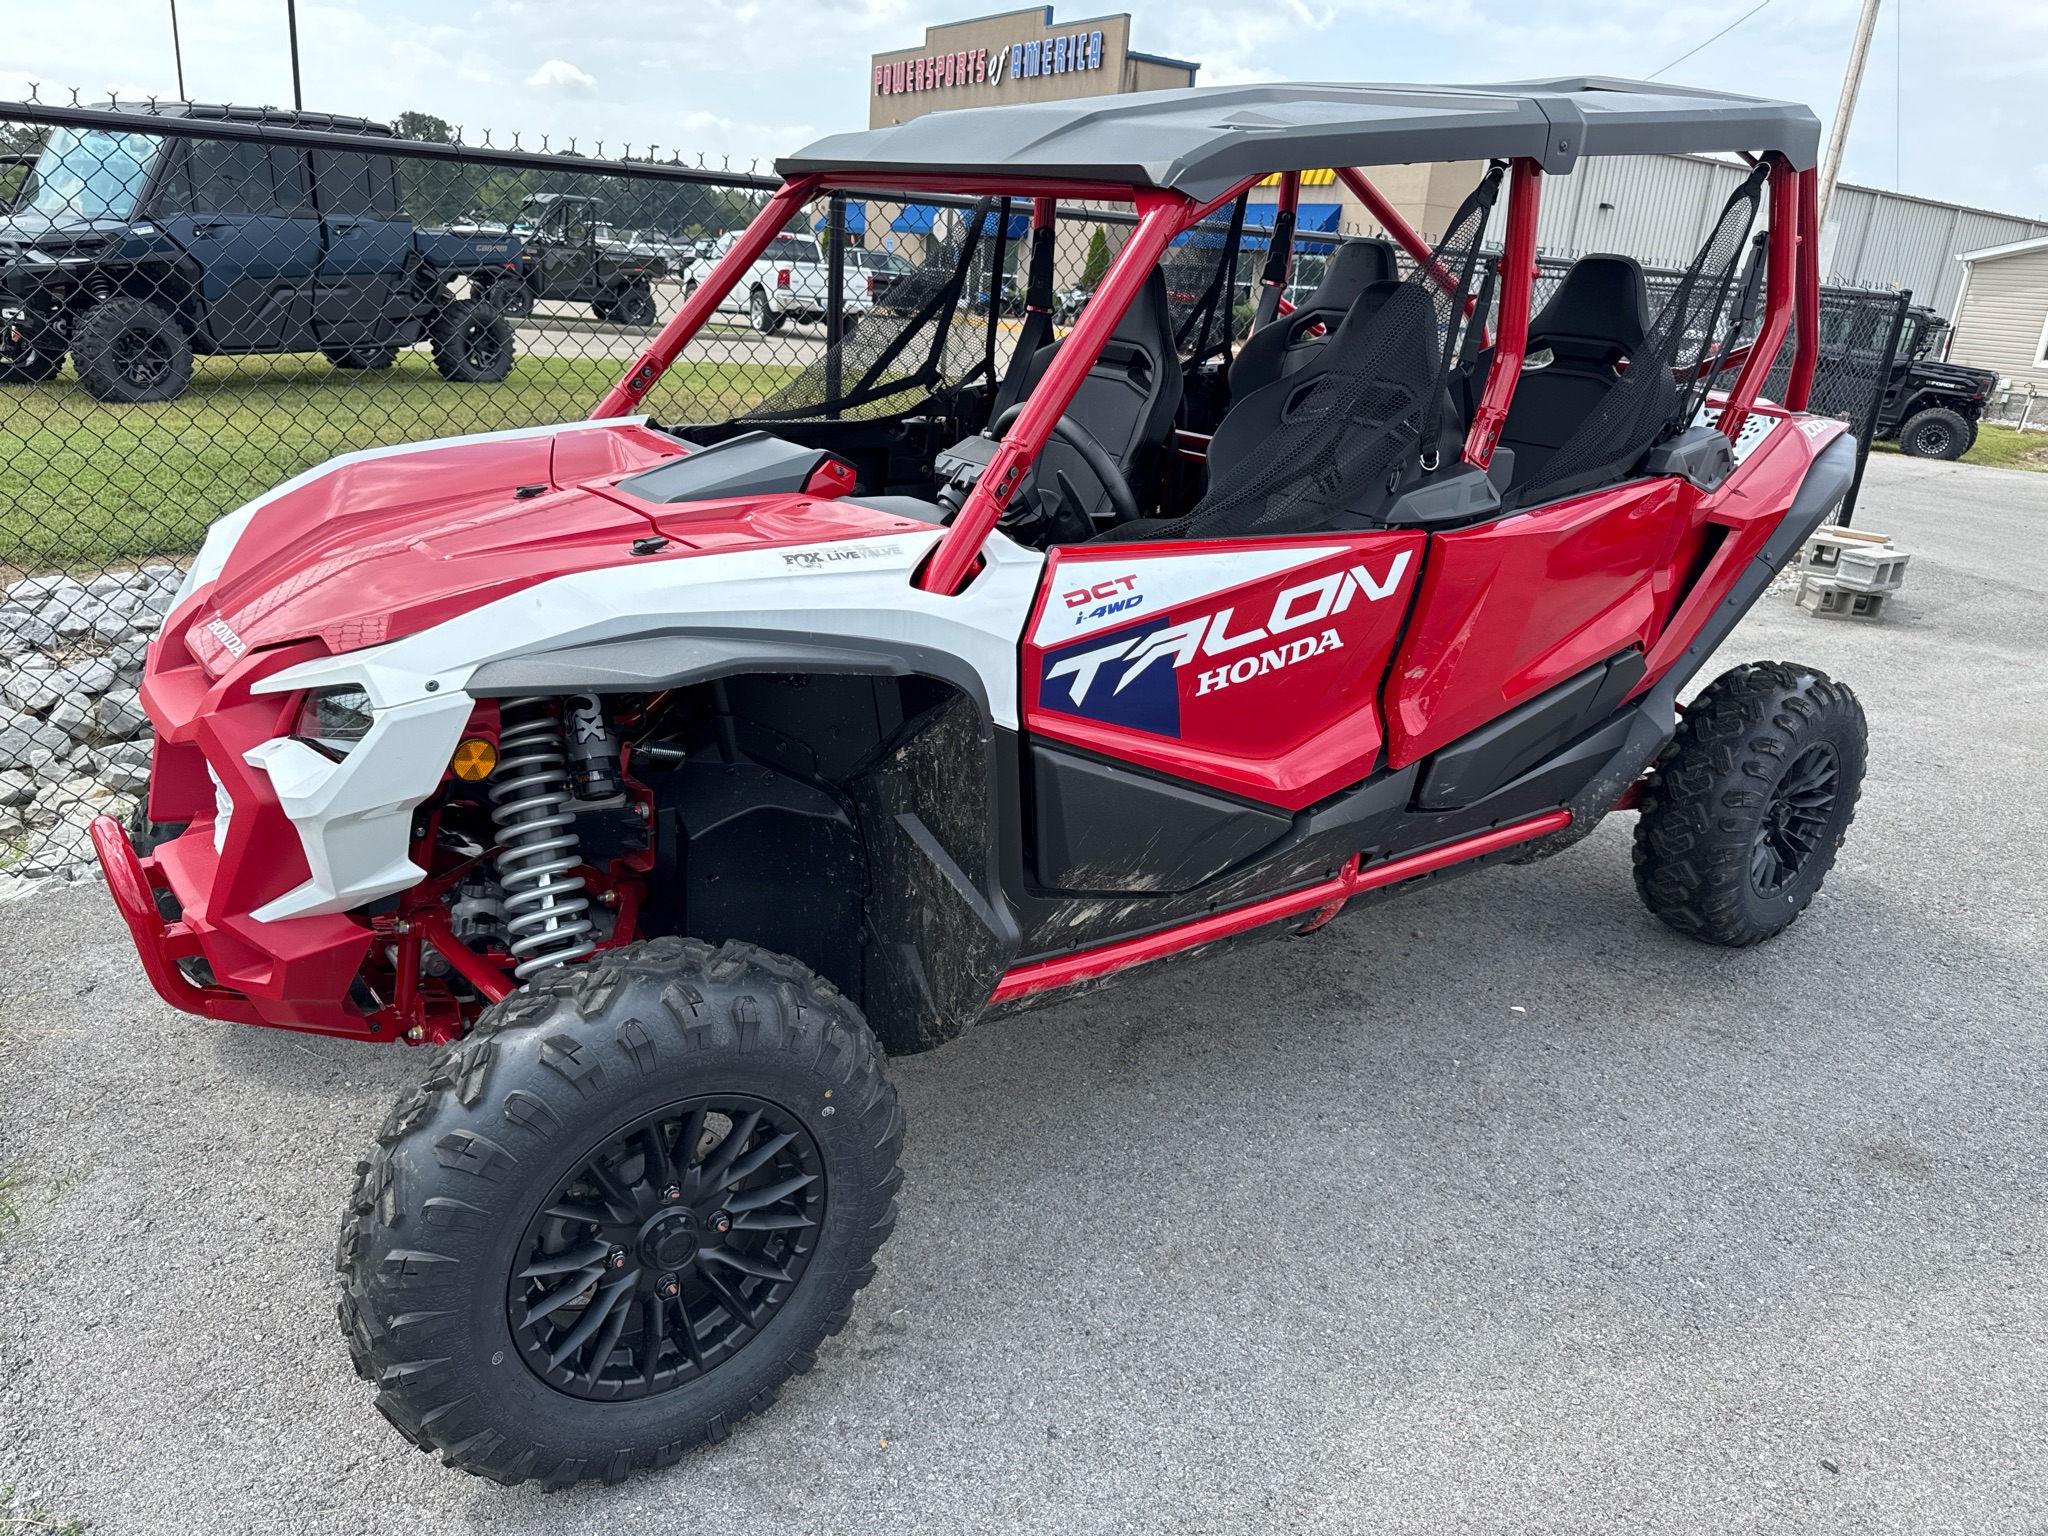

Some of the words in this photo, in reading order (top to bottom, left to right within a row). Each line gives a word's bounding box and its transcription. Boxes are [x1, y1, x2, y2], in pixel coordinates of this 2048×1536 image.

[874, 48, 987, 97] POWERSPORTS
[987, 45, 1010, 87] of
[1010, 31, 1104, 80] AMERICA
[782, 551, 823, 569] FOX
[1063, 574, 1138, 609] DCT
[1075, 595, 1143, 626] i-4WD
[206, 617, 248, 659] HONDA
[1045, 550, 1413, 707] TALON
[1195, 628, 1344, 697] HONDA
